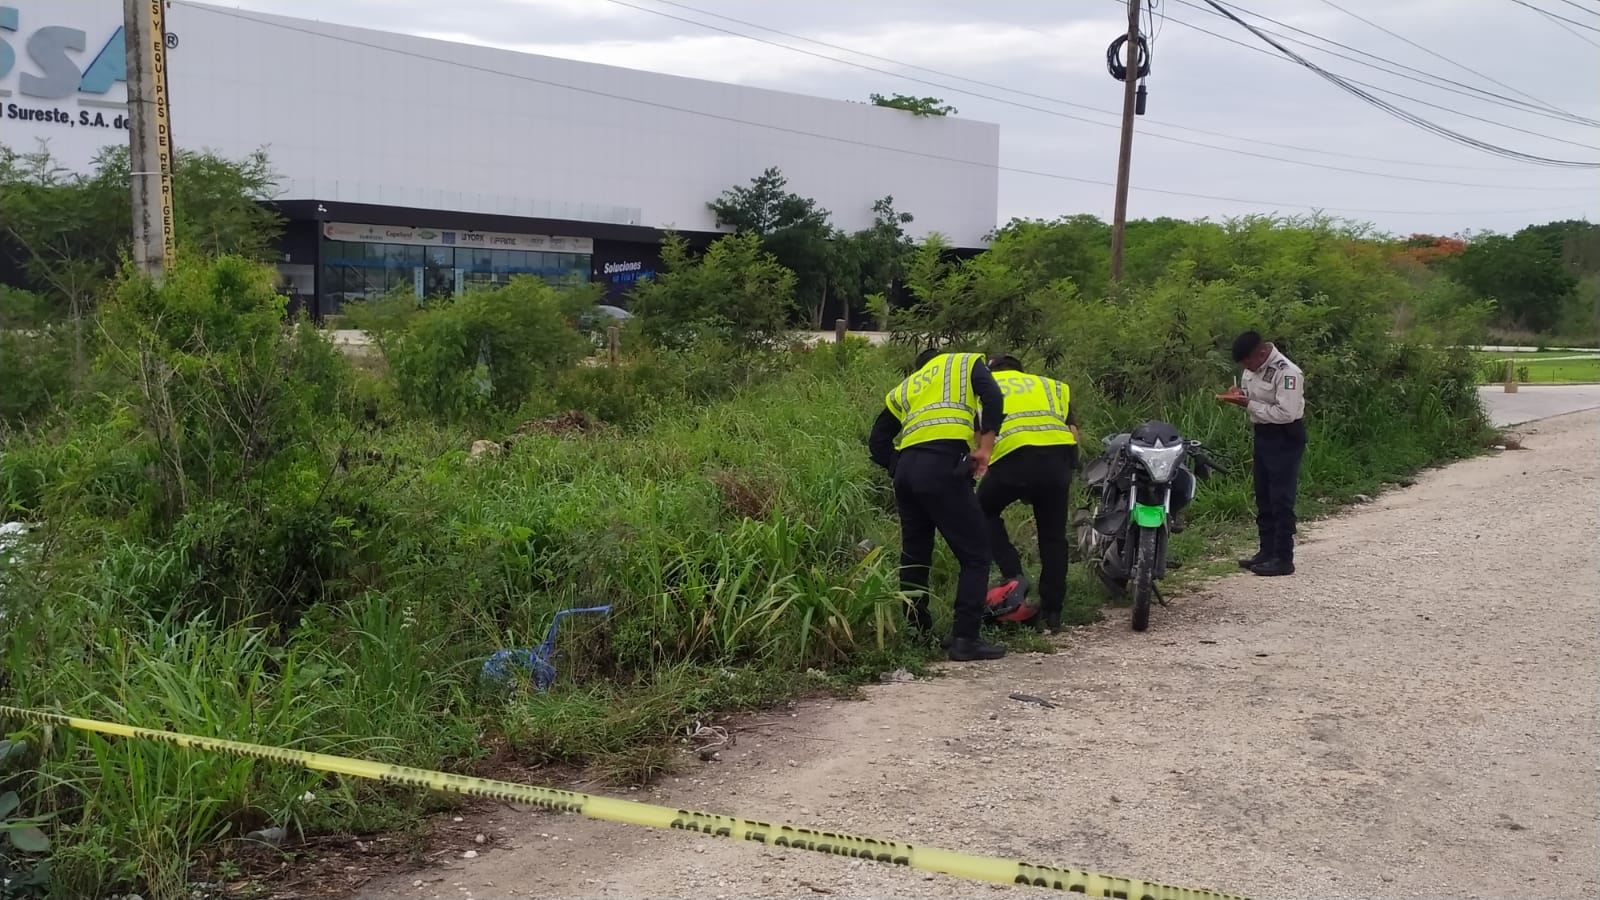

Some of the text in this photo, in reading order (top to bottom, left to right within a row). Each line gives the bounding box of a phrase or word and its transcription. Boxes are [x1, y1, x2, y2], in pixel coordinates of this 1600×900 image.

[153, 20, 160, 31] Y
[154, 42, 164, 118] EQUIPOS
[7, 103, 75, 128] Sureste,
[79, 110, 109, 128] S.A.
[158, 124, 167, 146] DE
[604, 260, 642, 274] Soluciones
[912, 365, 940, 394] SSP
[996, 377, 1035, 396] SSP
